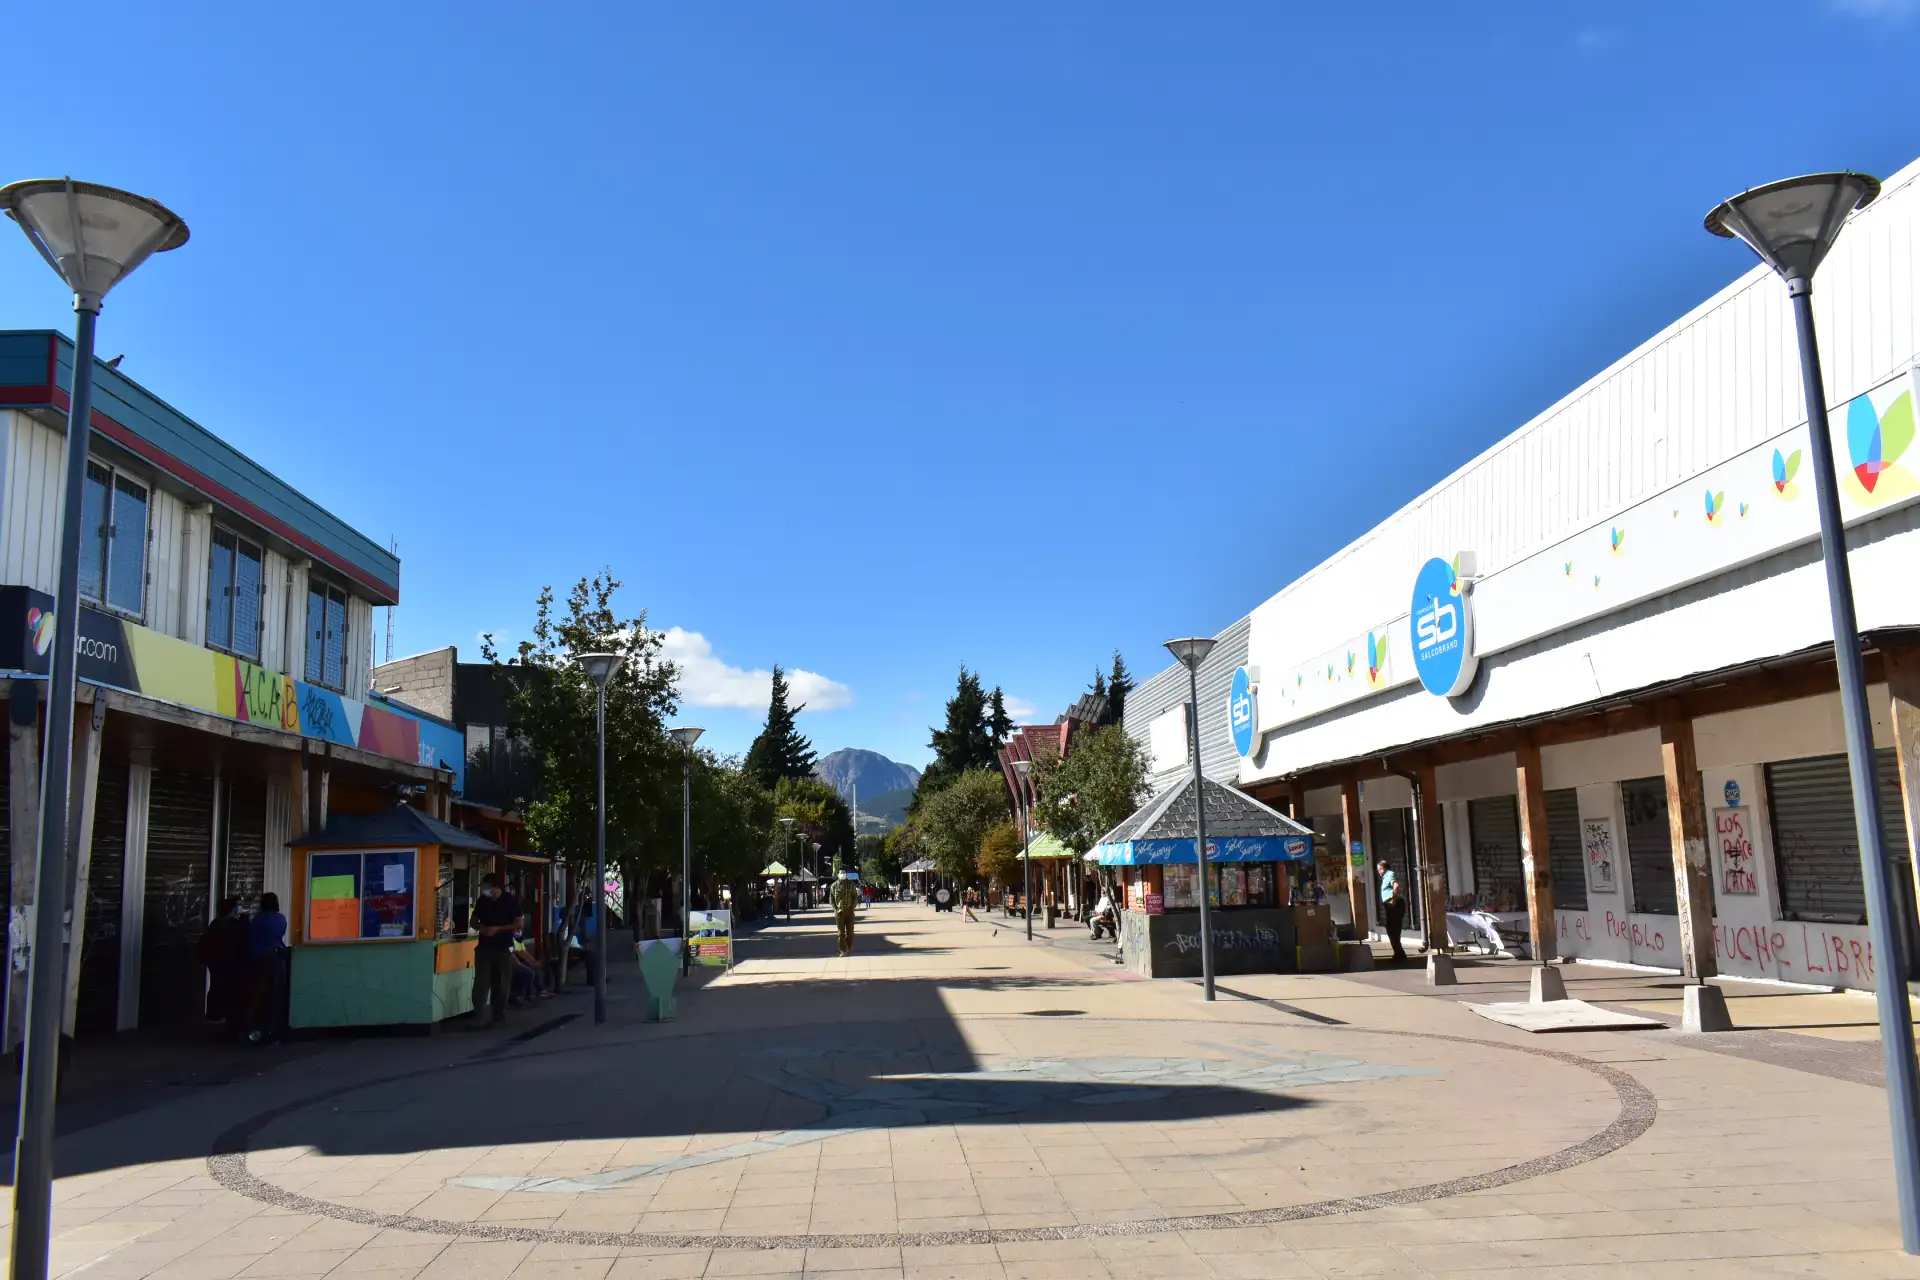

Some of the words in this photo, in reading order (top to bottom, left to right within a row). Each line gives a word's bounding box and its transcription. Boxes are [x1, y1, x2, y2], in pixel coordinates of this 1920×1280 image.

[1418, 597, 1456, 650] sb
[77, 635, 117, 664] r.com
[1420, 639, 1458, 661] SALCOBRAND
[1233, 692, 1250, 726] sb
